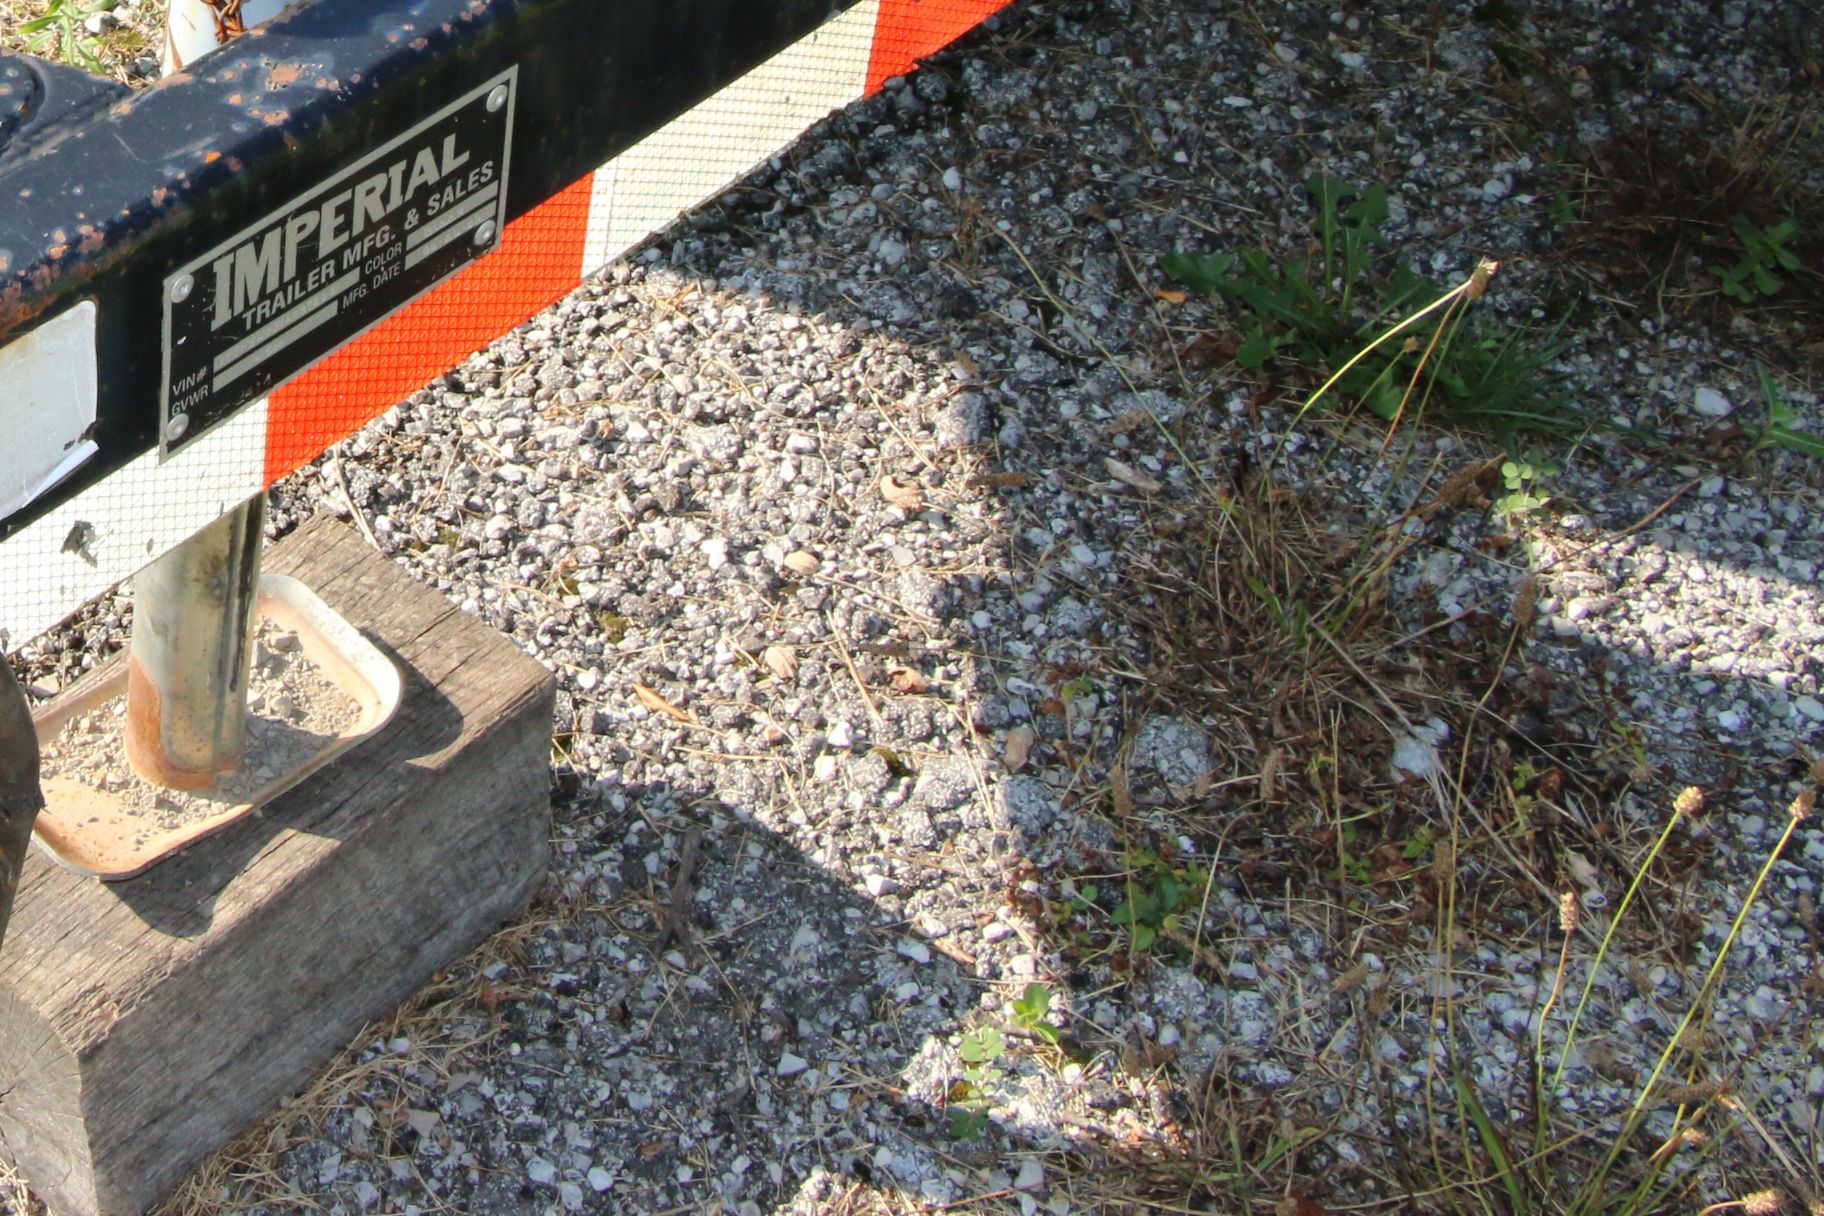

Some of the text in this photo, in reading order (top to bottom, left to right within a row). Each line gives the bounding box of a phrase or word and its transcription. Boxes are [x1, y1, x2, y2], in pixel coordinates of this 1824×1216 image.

[211, 133, 470, 332] IMPERIAL
[241, 261, 336, 331] TRAILER
[343, 224, 396, 270] MFG.
[404, 208, 420, 231] &
[427, 159, 495, 216] SALES
[365, 242, 403, 275] COLOR
[343, 285, 370, 309] MFG.
[373, 260, 401, 289] DATE
[171, 366, 207, 398] VIN#
[171, 384, 209, 416] GVWR
